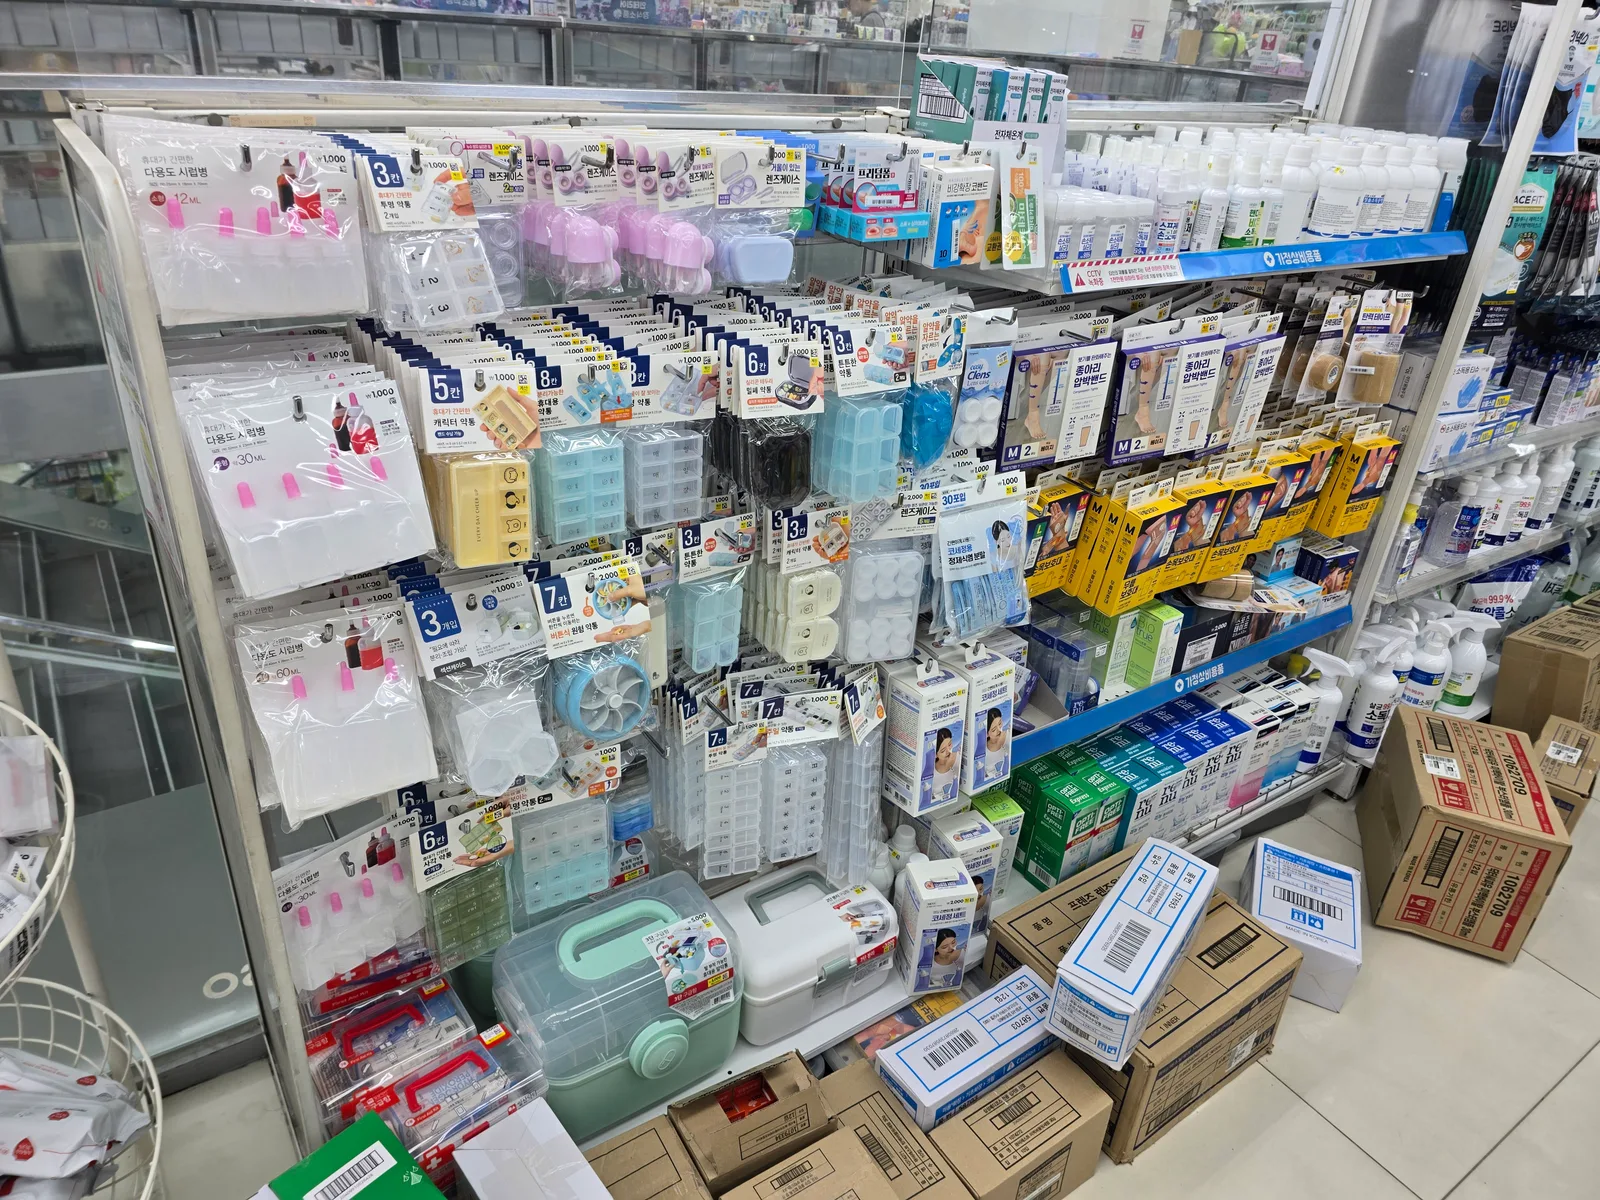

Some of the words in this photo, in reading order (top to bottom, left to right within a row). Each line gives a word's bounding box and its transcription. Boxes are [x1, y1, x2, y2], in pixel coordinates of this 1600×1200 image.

[995, 130, 1023, 141] 전자체온계
[142, 156, 167, 165] 휴대가
[145, 168, 176, 180] 다용도
[179, 167, 208, 180] 시럽병
[373, 162, 401, 186] 3칸
[771, 164, 788, 173] 거울이
[790, 163, 801, 172] 있는
[489, 171, 524, 182] 렌즈케이스
[690, 173, 714, 184] 렌즈케이스
[766, 174, 801, 186] 렌즈케이스
[970, 182, 988, 192] 코밴드
[380, 200, 394, 209] 투명
[397, 200, 411, 209] 약통
[939, 250, 949, 258] 10
[1275, 250, 1322, 266] 가정상비용품
[1086, 270, 1101, 278] CCTV
[1088, 278, 1104, 286] 녹화중
[1362, 313, 1391, 321] 탄력테이프
[923, 321, 941, 334] 알약을
[836, 333, 852, 353] 3칸
[922, 331, 941, 344] 자르는
[748, 352, 767, 374] 6칸
[838, 357, 857, 369] 튼튼한
[970, 363, 984, 371] easy
[1075, 362, 1102, 377] 종아리
[1184, 358, 1210, 372] 종아리
[1257, 356, 1273, 371] 종아리
[541, 369, 558, 387] 8칸
[839, 368, 852, 379] 약통
[967, 369, 991, 381] Clens
[1183, 369, 1216, 385] 압박밴드
[1073, 372, 1107, 389] 압박밴드
[433, 374, 460, 401] 5칸
[536, 388, 564, 398] 분리가능한
[760, 385, 772, 395] 약통
[537, 397, 559, 407] 휴대용
[637, 398, 651, 407] 약통
[433, 407, 451, 415] 휴대가
[452, 407, 470, 415] 간편한
[538, 406, 552, 416] 약통
[433, 418, 458, 428] 캐릭터
[460, 417, 475, 428] 약통
[206, 431, 235, 446] 다용도
[1008, 446, 1019, 458] M
[1118, 440, 1129, 452] M
[237, 453, 254, 466] 30
[255, 455, 266, 463] ML
[1350, 454, 1360, 465] M
[942, 492, 967, 506] 30포입
[900, 506, 937, 518] 렌즈케이스
[1092, 501, 1103, 514] M
[1108, 512, 1118, 525] M
[790, 520, 807, 539] 3칸
[1125, 523, 1136, 536] M
[685, 529, 700, 547] 3칸
[684, 548, 704, 562] 튼튼한
[948, 544, 973, 556] 코세정용
[684, 559, 697, 569] 약통
[949, 552, 974, 566] 정제식염
[974, 550, 986, 561] 분말
[544, 586, 568, 610] 7칸
[421, 610, 458, 637] 3개입
[1137, 617, 1155, 633] BIO
[550, 628, 570, 640] 버튼식
[571, 625, 584, 636] 원형
[585, 621, 599, 632] 약통
[1136, 626, 1153, 643] true
[279, 643, 304, 656] 시럽병
[276, 667, 291, 679] 60
[1185, 662, 1224, 688] 가정상비용품
[982, 690, 997, 702] 코세정
[766, 702, 781, 717] 7칸
[1369, 702, 1382, 711] 살균
[932, 708, 949, 722] 코세정
[781, 725, 794, 735] 약통
[711, 732, 725, 747] 7칸
[1224, 751, 1242, 765] nu
[1092, 774, 1107, 788] FREE
[1501, 753, 1528, 797] 1062709
[1064, 786, 1081, 799] FREE
[1097, 782, 1117, 794] Express
[1069, 793, 1090, 806] Express
[1135, 805, 1153, 821] nu
[1074, 818, 1095, 836] FREE
[423, 830, 446, 851] 6칸
[423, 857, 437, 868] 사각
[438, 851, 453, 862] 약통
[300, 870, 320, 886] 시럽병
[1489, 873, 1520, 918] 1062709
[1067, 893, 1094, 912] 프렌즈
[1285, 925, 1302, 935] MADE
[1308, 934, 1329, 945] KOREA
[994, 990, 1010, 1003] 12입
[1011, 1013, 1032, 1029] 58703
